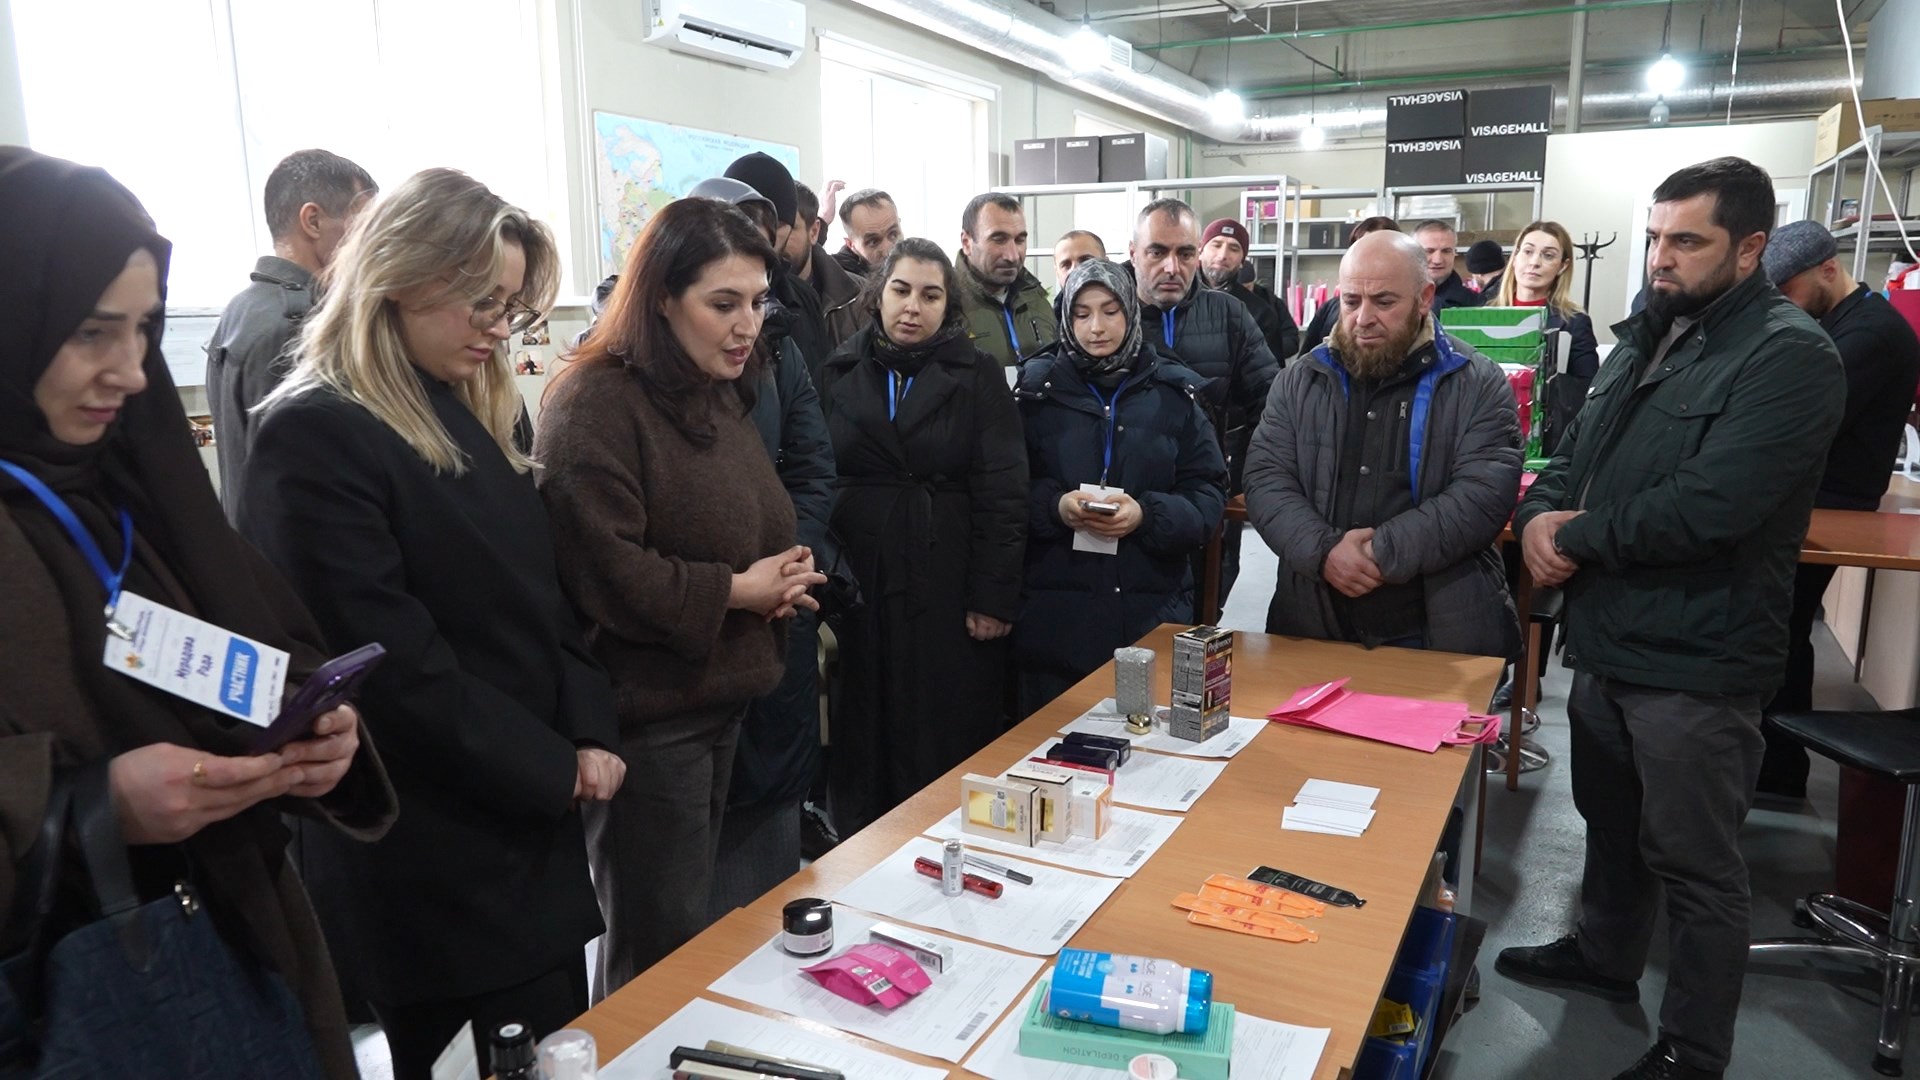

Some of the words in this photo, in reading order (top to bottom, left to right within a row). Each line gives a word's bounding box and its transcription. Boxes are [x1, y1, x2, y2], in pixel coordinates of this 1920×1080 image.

[1389, 91, 1464, 107] VISAGEHALL
[1471, 122, 1549, 137] VISAGEHALL
[1388, 140, 1462, 153] VISAGEHALL
[1465, 171, 1542, 184] VISAGEHALL
[228, 651, 251, 704] УЧАСТНИК
[1063, 1047, 1120, 1061] DEPILATION
